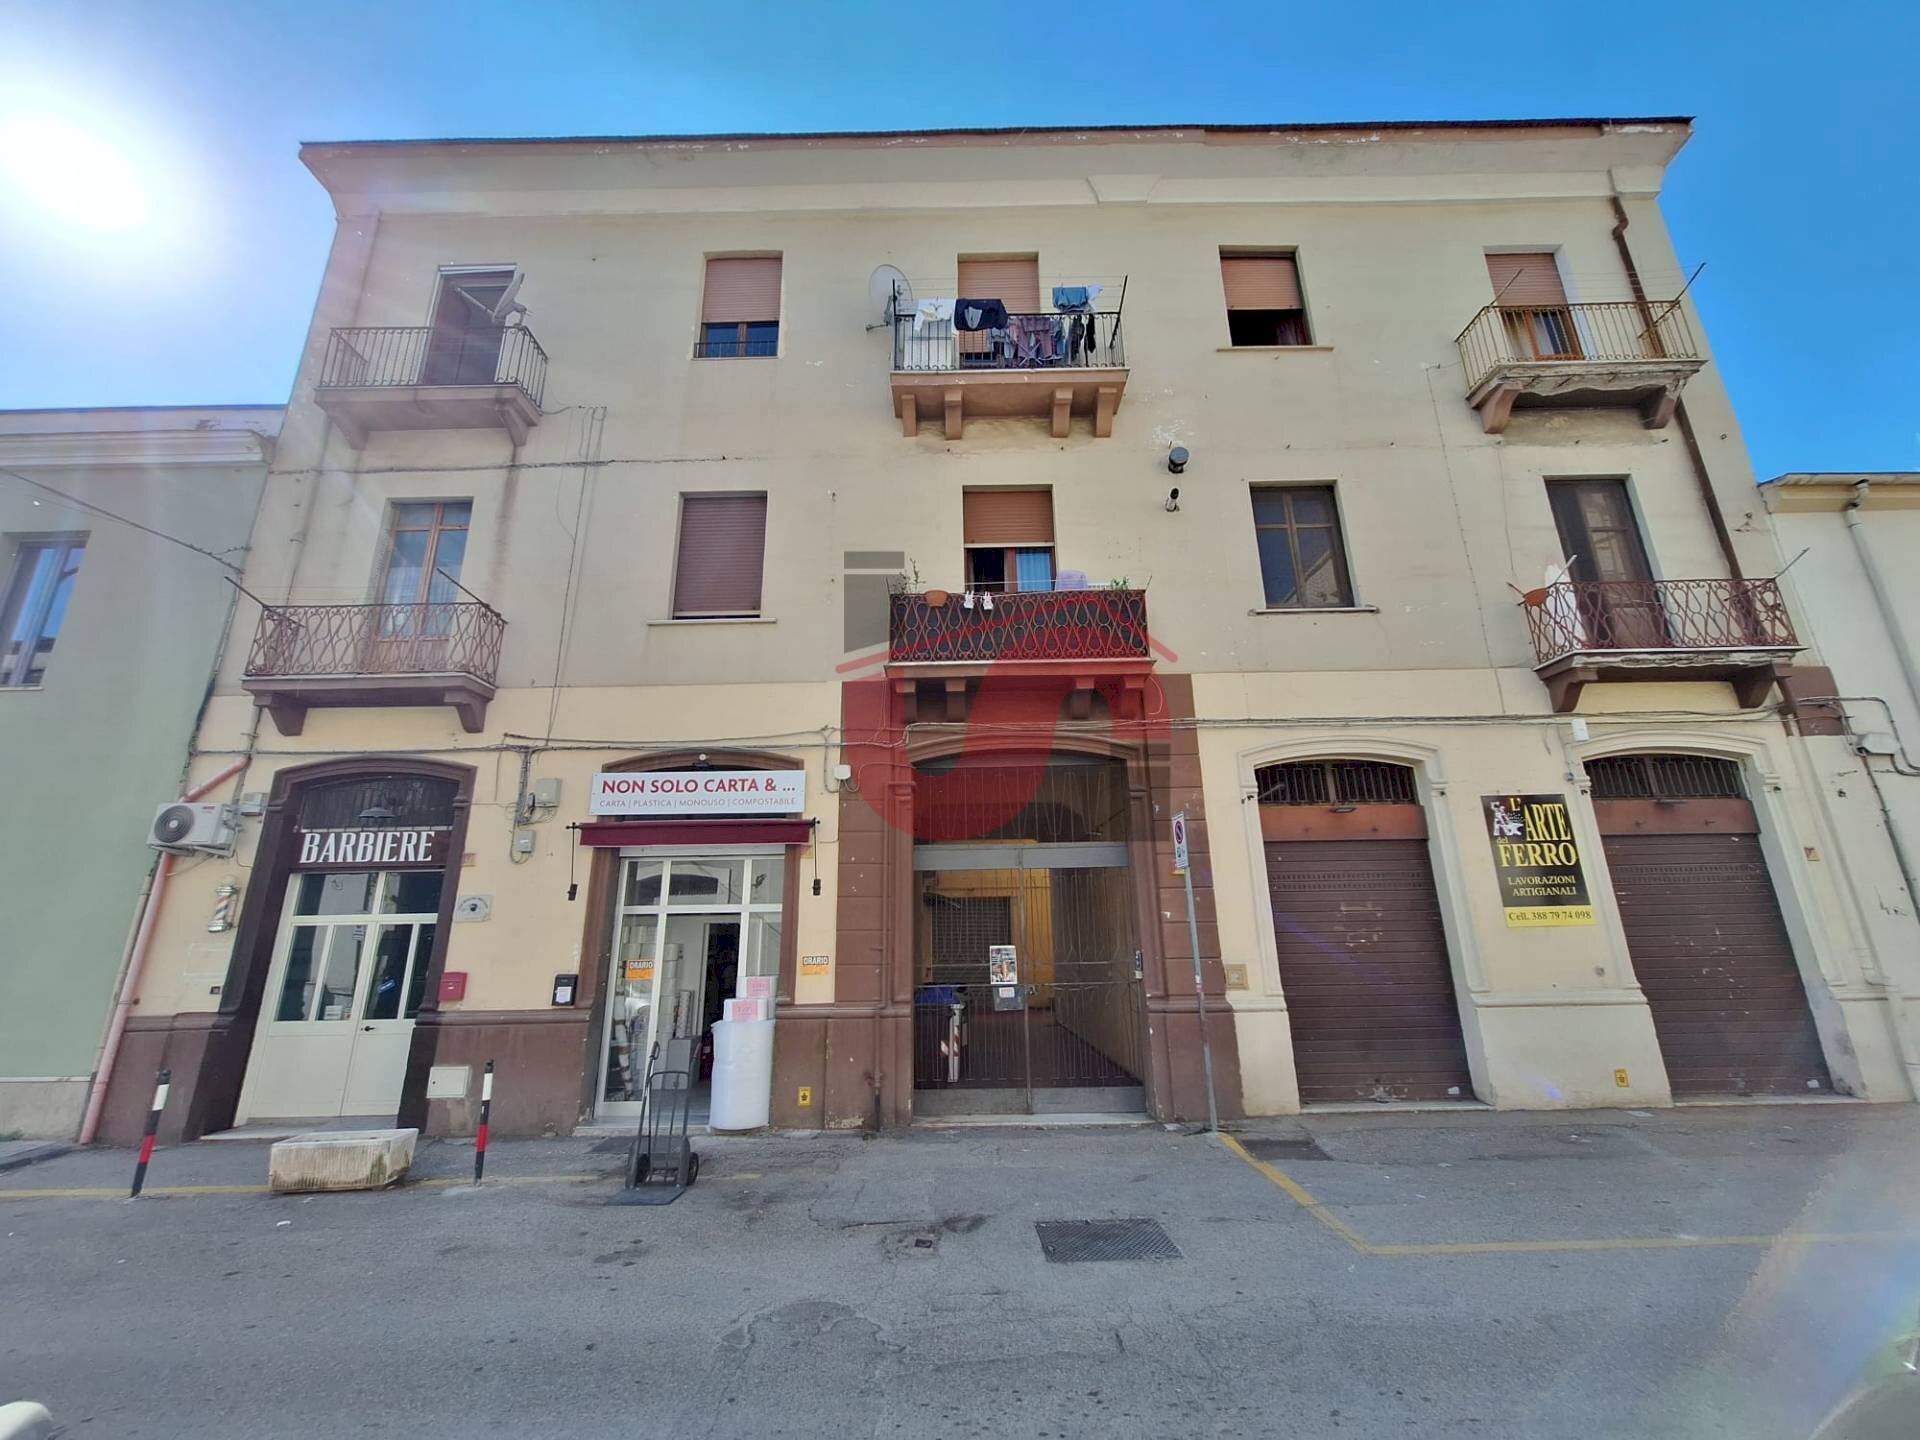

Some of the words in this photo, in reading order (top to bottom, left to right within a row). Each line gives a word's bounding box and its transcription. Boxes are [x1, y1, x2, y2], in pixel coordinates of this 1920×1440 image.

[602, 779, 645, 794] NON
[650, 778, 698, 793] SOLO
[704, 778, 759, 792] CARTA
[764, 778, 777, 791] &
[600, 800, 626, 808] CARTA
[633, 799, 672, 807] PLASTICA
[679, 798, 726, 807] MONOUSO
[732, 797, 796, 806] COMPOSTABILE
[1523, 803, 1572, 841] ARTE
[299, 831, 435, 863] BARBIERE
[1499, 842, 1578, 867] FERRO
[1507, 875, 1576, 885] LAVORAZIONI
[1512, 887, 1577, 896] ARTIGIANALI
[1532, 911, 1548, 920] 388
